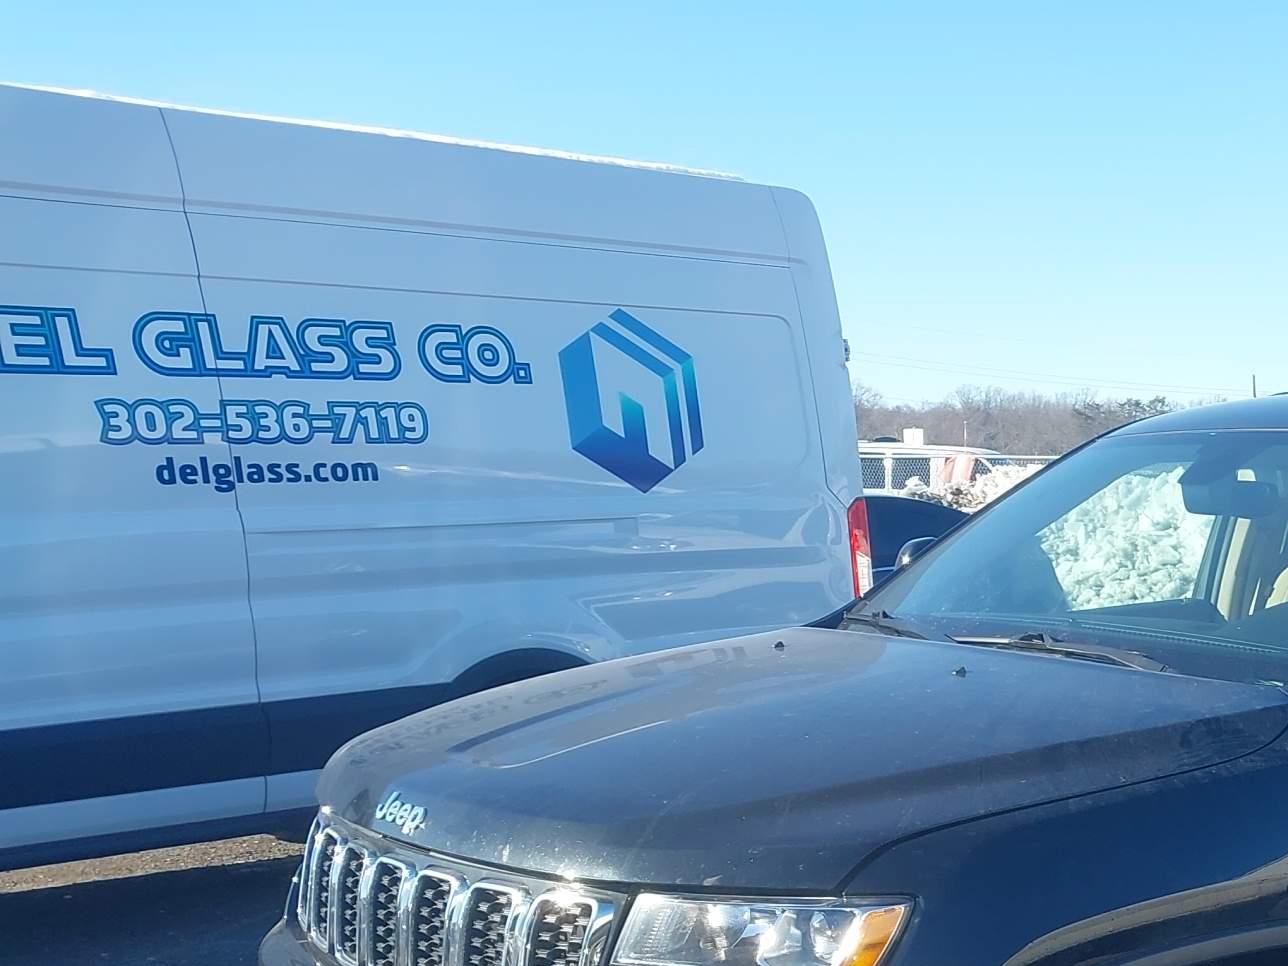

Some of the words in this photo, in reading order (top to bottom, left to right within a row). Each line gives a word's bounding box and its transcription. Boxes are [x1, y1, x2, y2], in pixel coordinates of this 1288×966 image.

[132, 311, 401, 381] GLASS
[417, 322, 532, 384] CO.
[96, 398, 430, 445] 302-536-7119
[155, 456, 379, 492] delglass.com
[375, 791, 427, 836] Jeep
